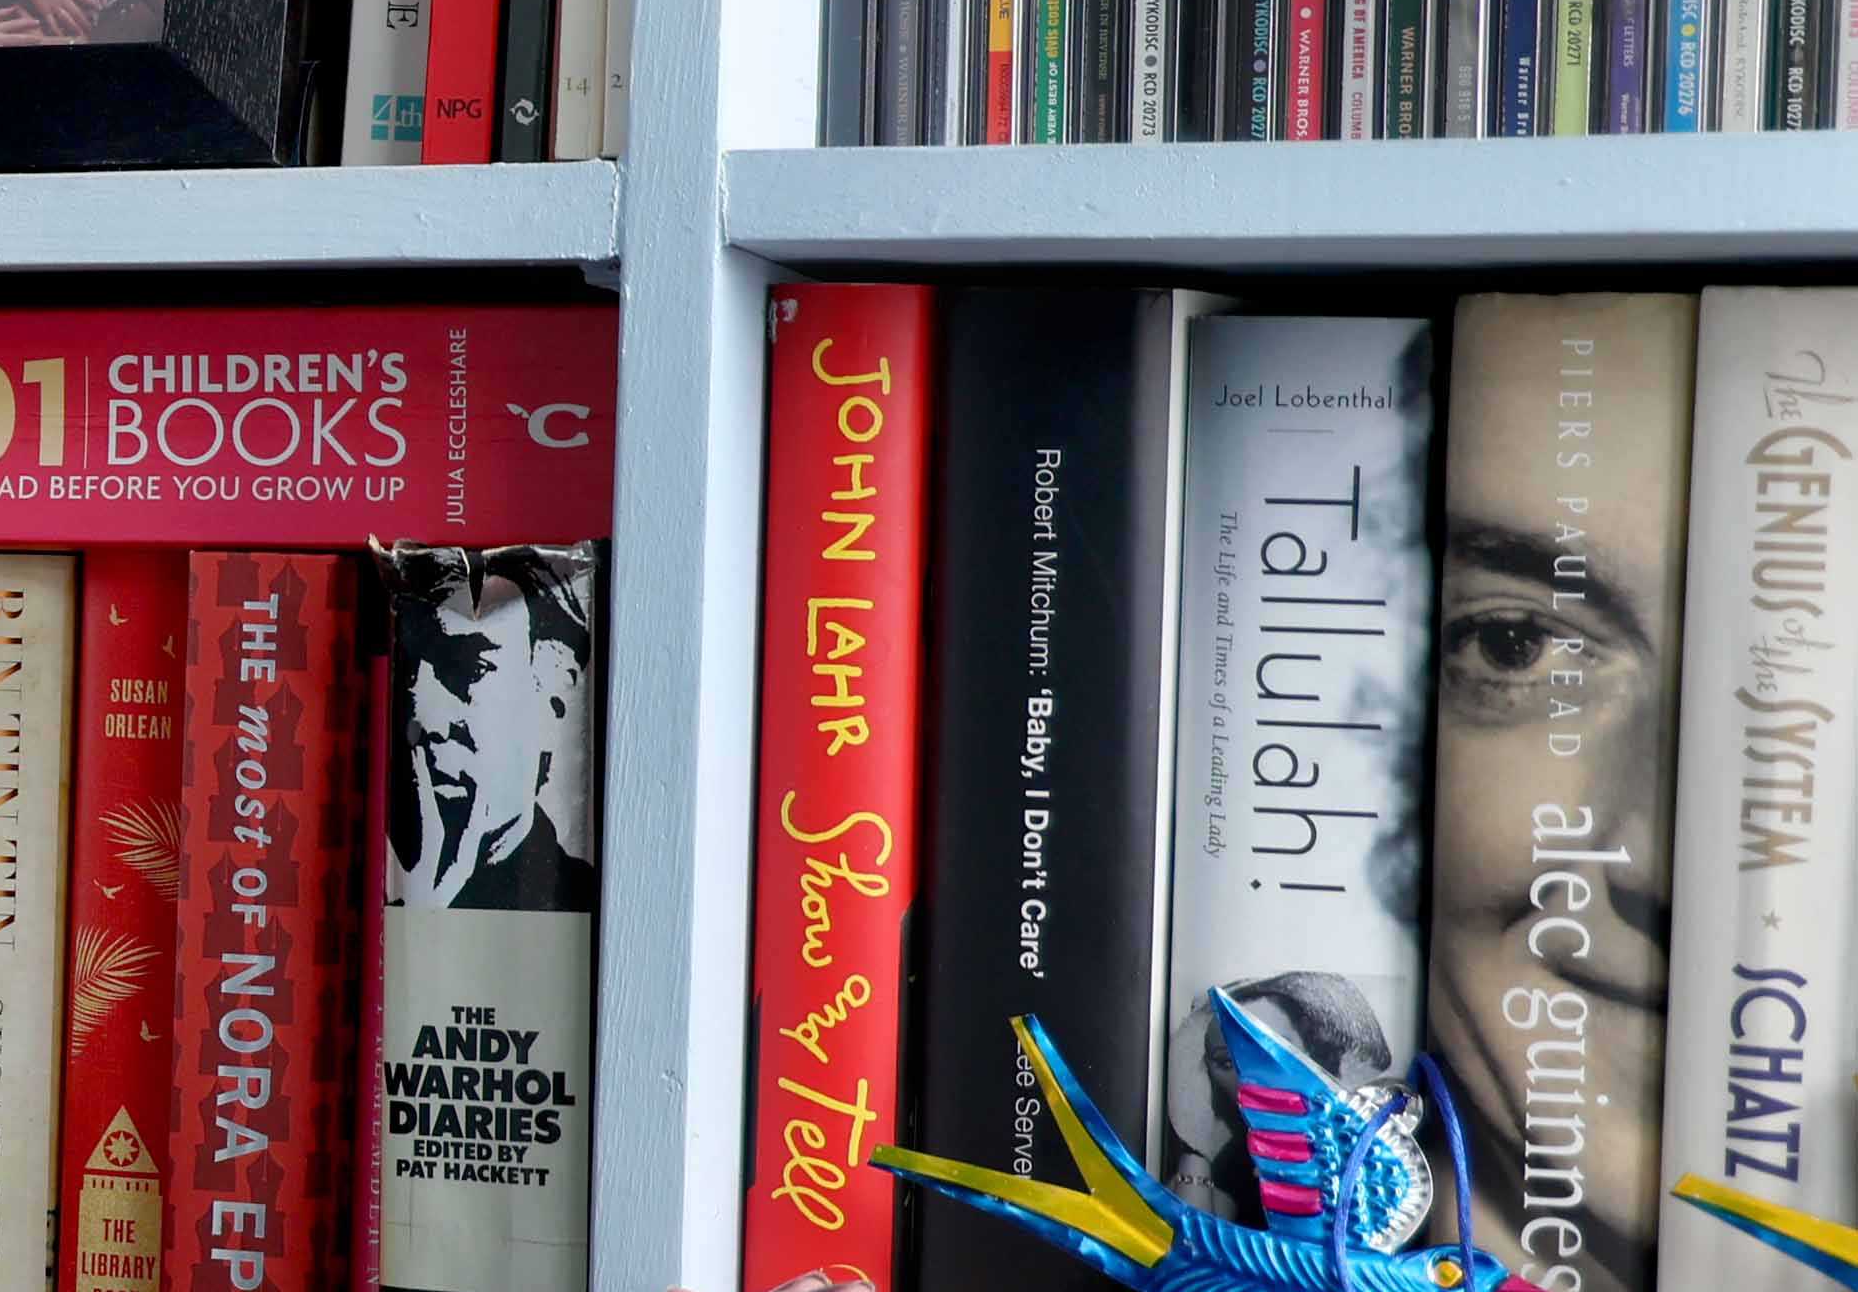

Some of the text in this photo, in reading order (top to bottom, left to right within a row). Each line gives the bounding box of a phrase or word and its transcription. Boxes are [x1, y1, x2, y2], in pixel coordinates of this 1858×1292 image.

[108, 350, 407, 393] CHILDREN'S
[1214, 384, 1393, 411] Joel Lobenthal
[108, 397, 407, 468] BOOKS
[447, 327, 468, 525] JULIA ECCLESHARE
[48, 474, 161, 500] BEFORE
[172, 474, 241, 500] YOU
[251, 474, 353, 500] GROW
[363, 474, 405, 500] UP
[1033, 448, 1062, 541] Robert
[1028, 550, 1061, 676] Mitchum:
[1249, 464, 1387, 894] Tallulah!
[769, 338, 893, 1231] JOHN LAHR Show and Tell
[1025, 789, 1050, 800] I
[450, 1004, 496, 1026] THE
[214, 953, 276, 1163] NORA
[411, 1026, 540, 1064] ANDY
[384, 1063, 576, 1107] WARHOL
[1724, 963, 1808, 1184] SCHATZ
[387, 1106, 561, 1144] DIARIES
[103, 1218, 136, 1244] THE
[81, 1252, 156, 1281] LIBRARY
